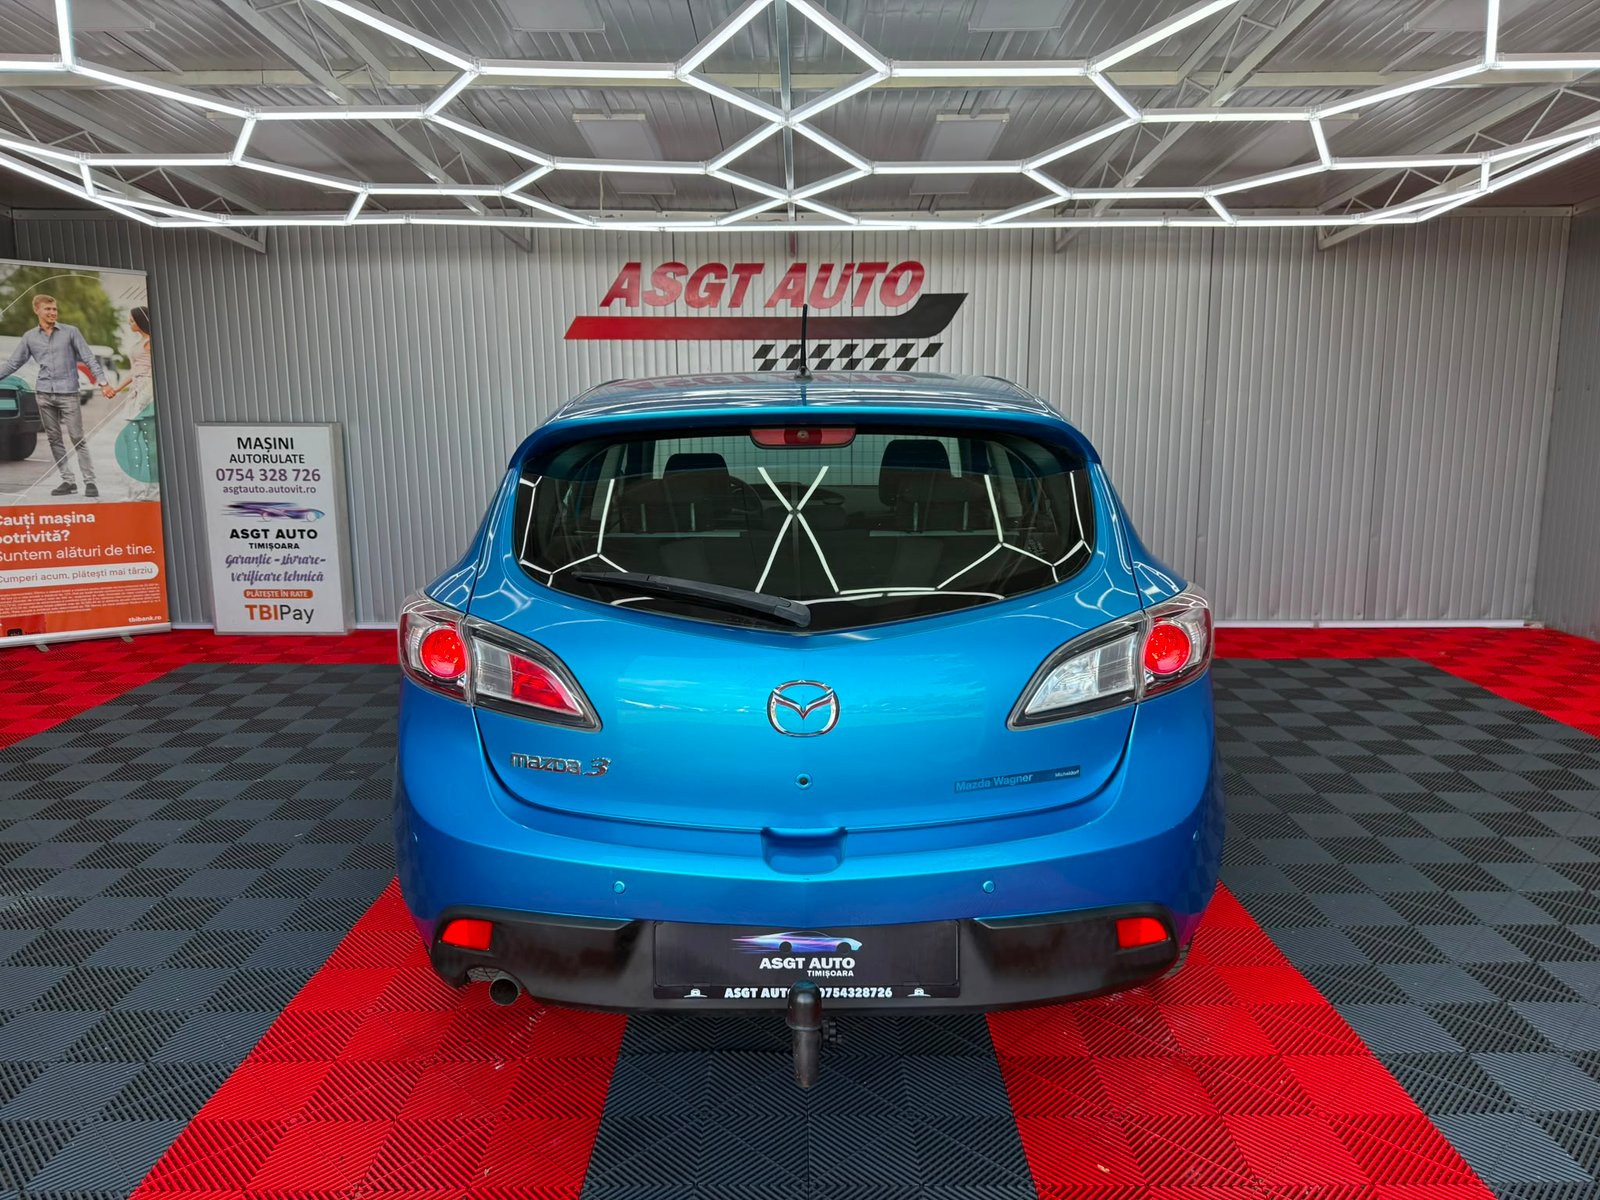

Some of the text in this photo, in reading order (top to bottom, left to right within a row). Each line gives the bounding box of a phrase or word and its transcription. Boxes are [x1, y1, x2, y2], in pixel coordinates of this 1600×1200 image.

[599, 260, 926, 310] ASGT AUTO
[237, 437, 294, 452] MAȘINI
[229, 454, 305, 464] AUTORULATE
[216, 468, 321, 482] 0754 328 726
[223, 484, 317, 496] asgtauto.autovit.ro
[0, 529, 71, 544] otrivită?
[229, 528, 319, 539] ASGT AUTO
[56, 545, 101, 559] alături
[104, 545, 123, 556] de
[126, 543, 156, 555] tine.
[248, 542, 300, 551] TIMIȘOARA
[109, 567, 126, 576] mai
[128, 565, 153, 575] târziu
[281, 589, 289, 597] ÎN
[128, 615, 162, 623] tbibank.ro
[244, 604, 314, 624] TBIPay
[582, 757, 612, 777] 3
[956, 779, 991, 792] Mazda
[993, 773, 1034, 786] Wagner
[759, 957, 856, 970] ASGT AUTO
[807, 970, 854, 979] TIMIȘOARA
[724, 987, 758, 999] ASGT
[760, 987, 790, 999] AUT
